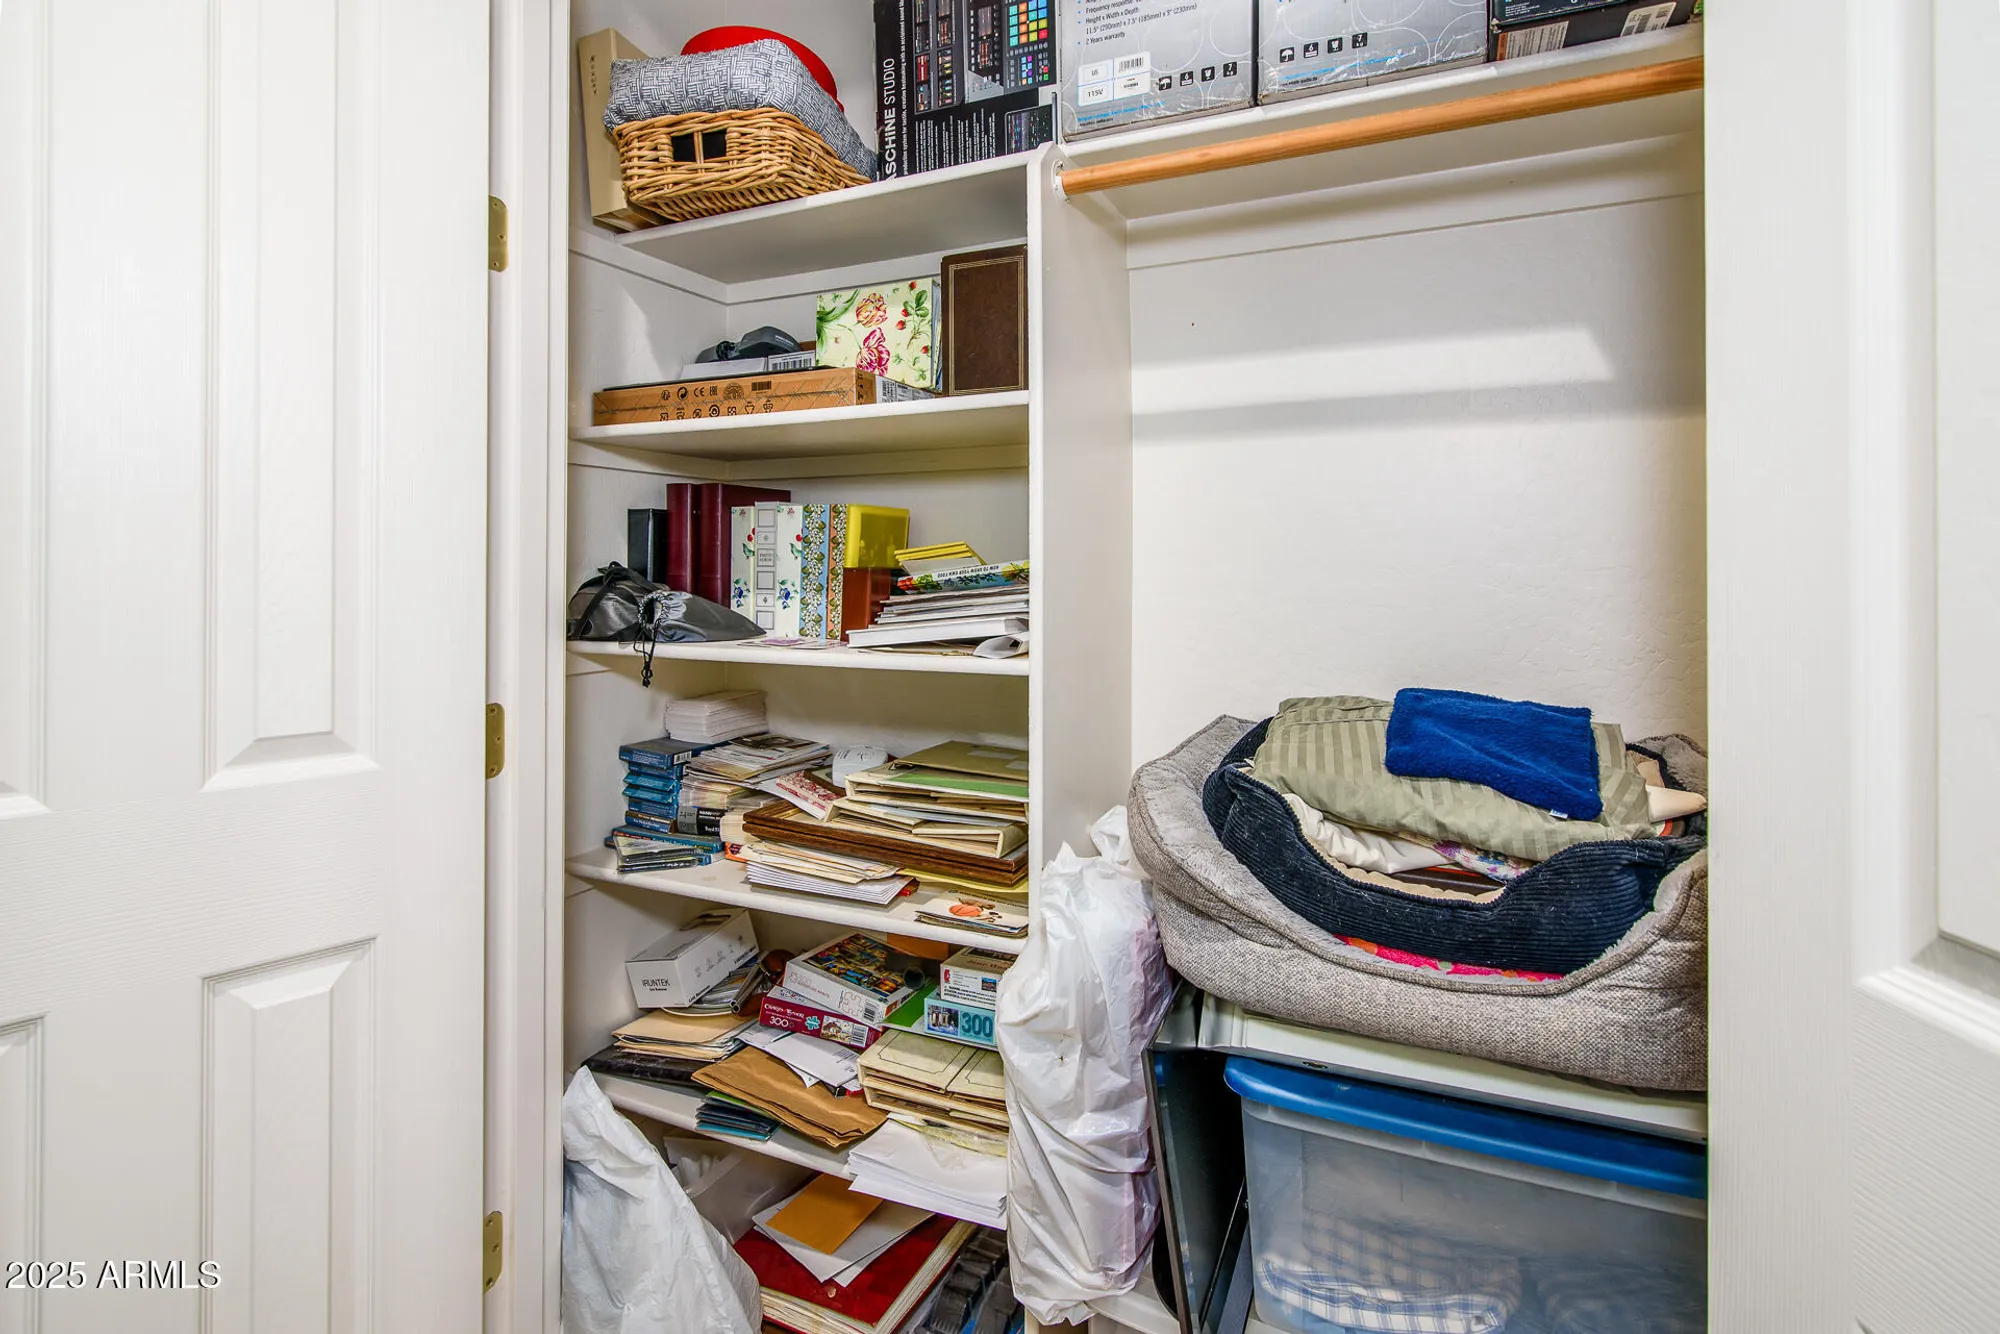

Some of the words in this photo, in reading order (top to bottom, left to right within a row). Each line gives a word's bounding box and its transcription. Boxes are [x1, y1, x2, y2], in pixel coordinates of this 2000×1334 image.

[882, 58, 896, 106] STUDIO
[769, 1015, 789, 1027] 300
[961, 1011, 993, 1038] 300
